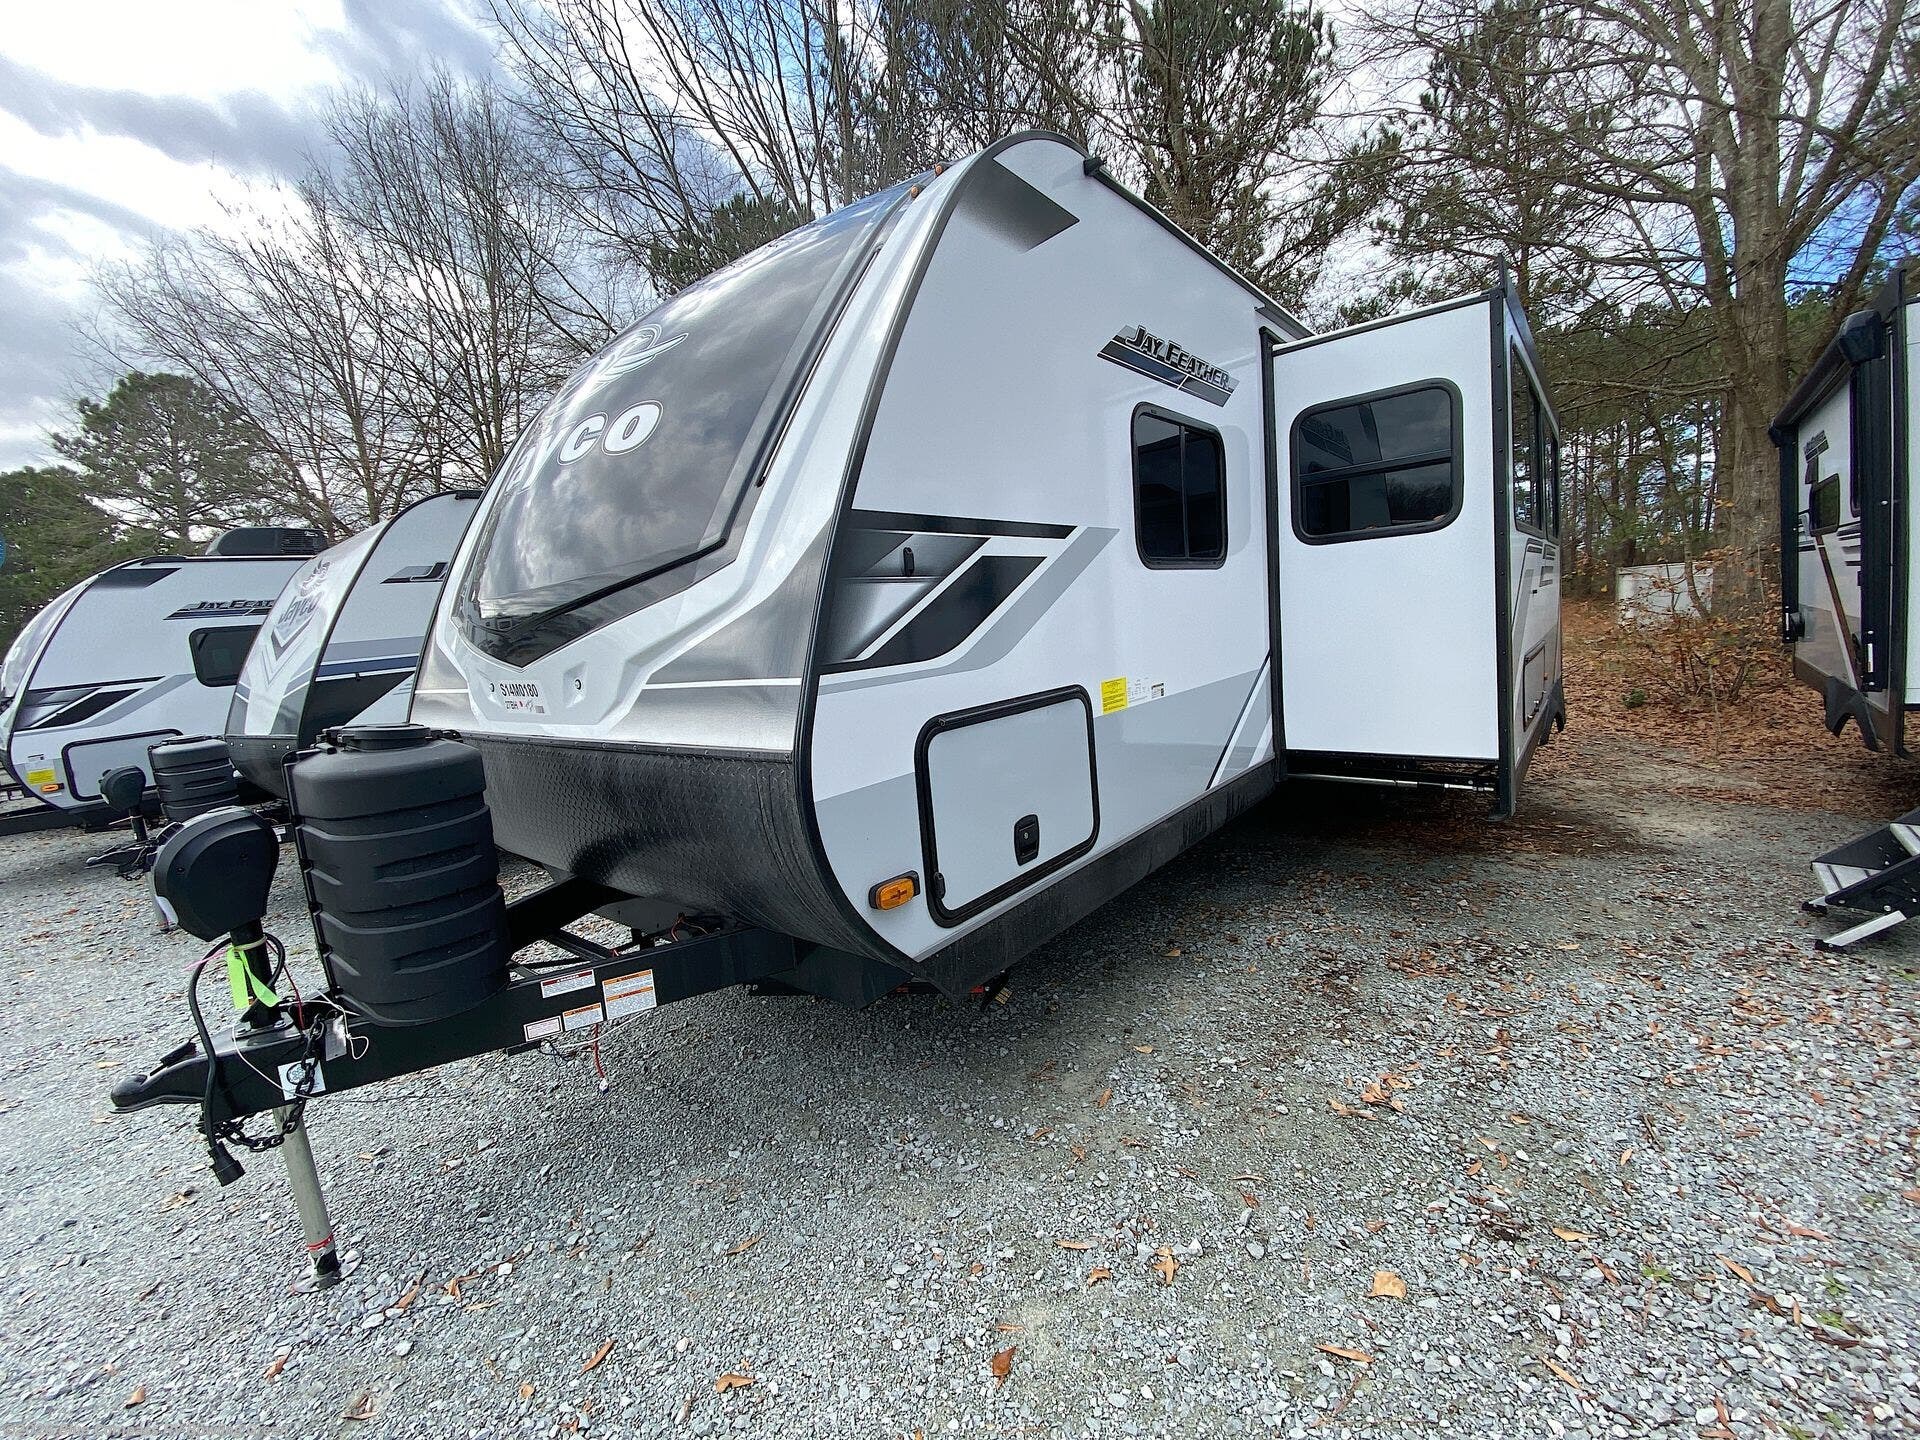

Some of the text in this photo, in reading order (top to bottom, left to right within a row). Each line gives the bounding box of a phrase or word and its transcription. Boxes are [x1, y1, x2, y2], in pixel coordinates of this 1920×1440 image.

[1126, 324, 1231, 390] JAY FEATHER
[229, 599, 275, 608] FEAT
[279, 592, 323, 625] Jayco
[499, 683, 539, 698] S14M0180
